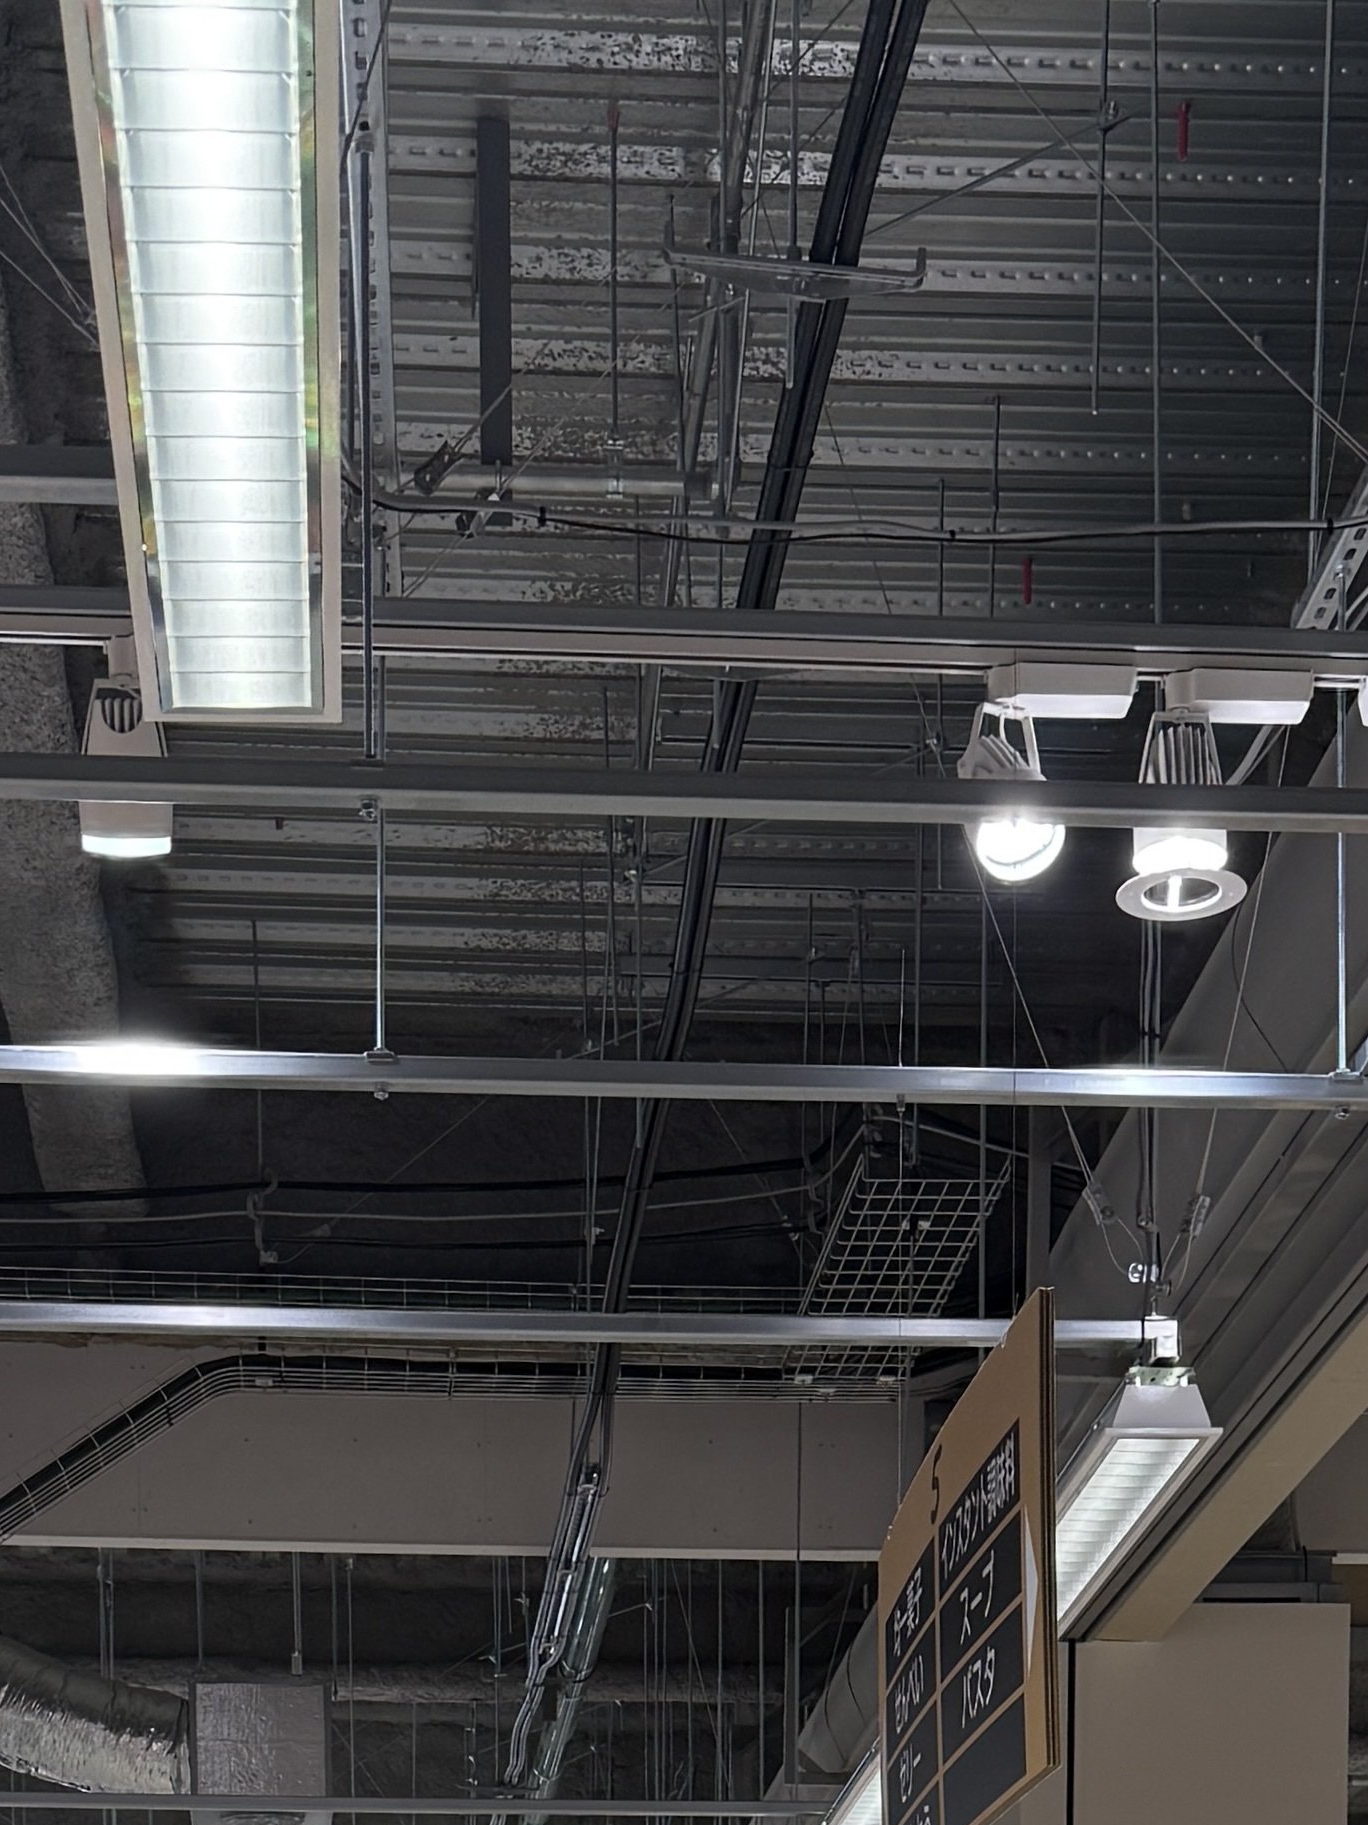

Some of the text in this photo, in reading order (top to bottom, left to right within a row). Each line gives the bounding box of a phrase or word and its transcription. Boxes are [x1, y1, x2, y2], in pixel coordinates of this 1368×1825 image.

[931, 1445, 943, 1524] 5
[960, 1550, 996, 1645] スープ
[961, 1647, 997, 1728] パスタ
[898, 1752, 922, 1804] ゼリー
